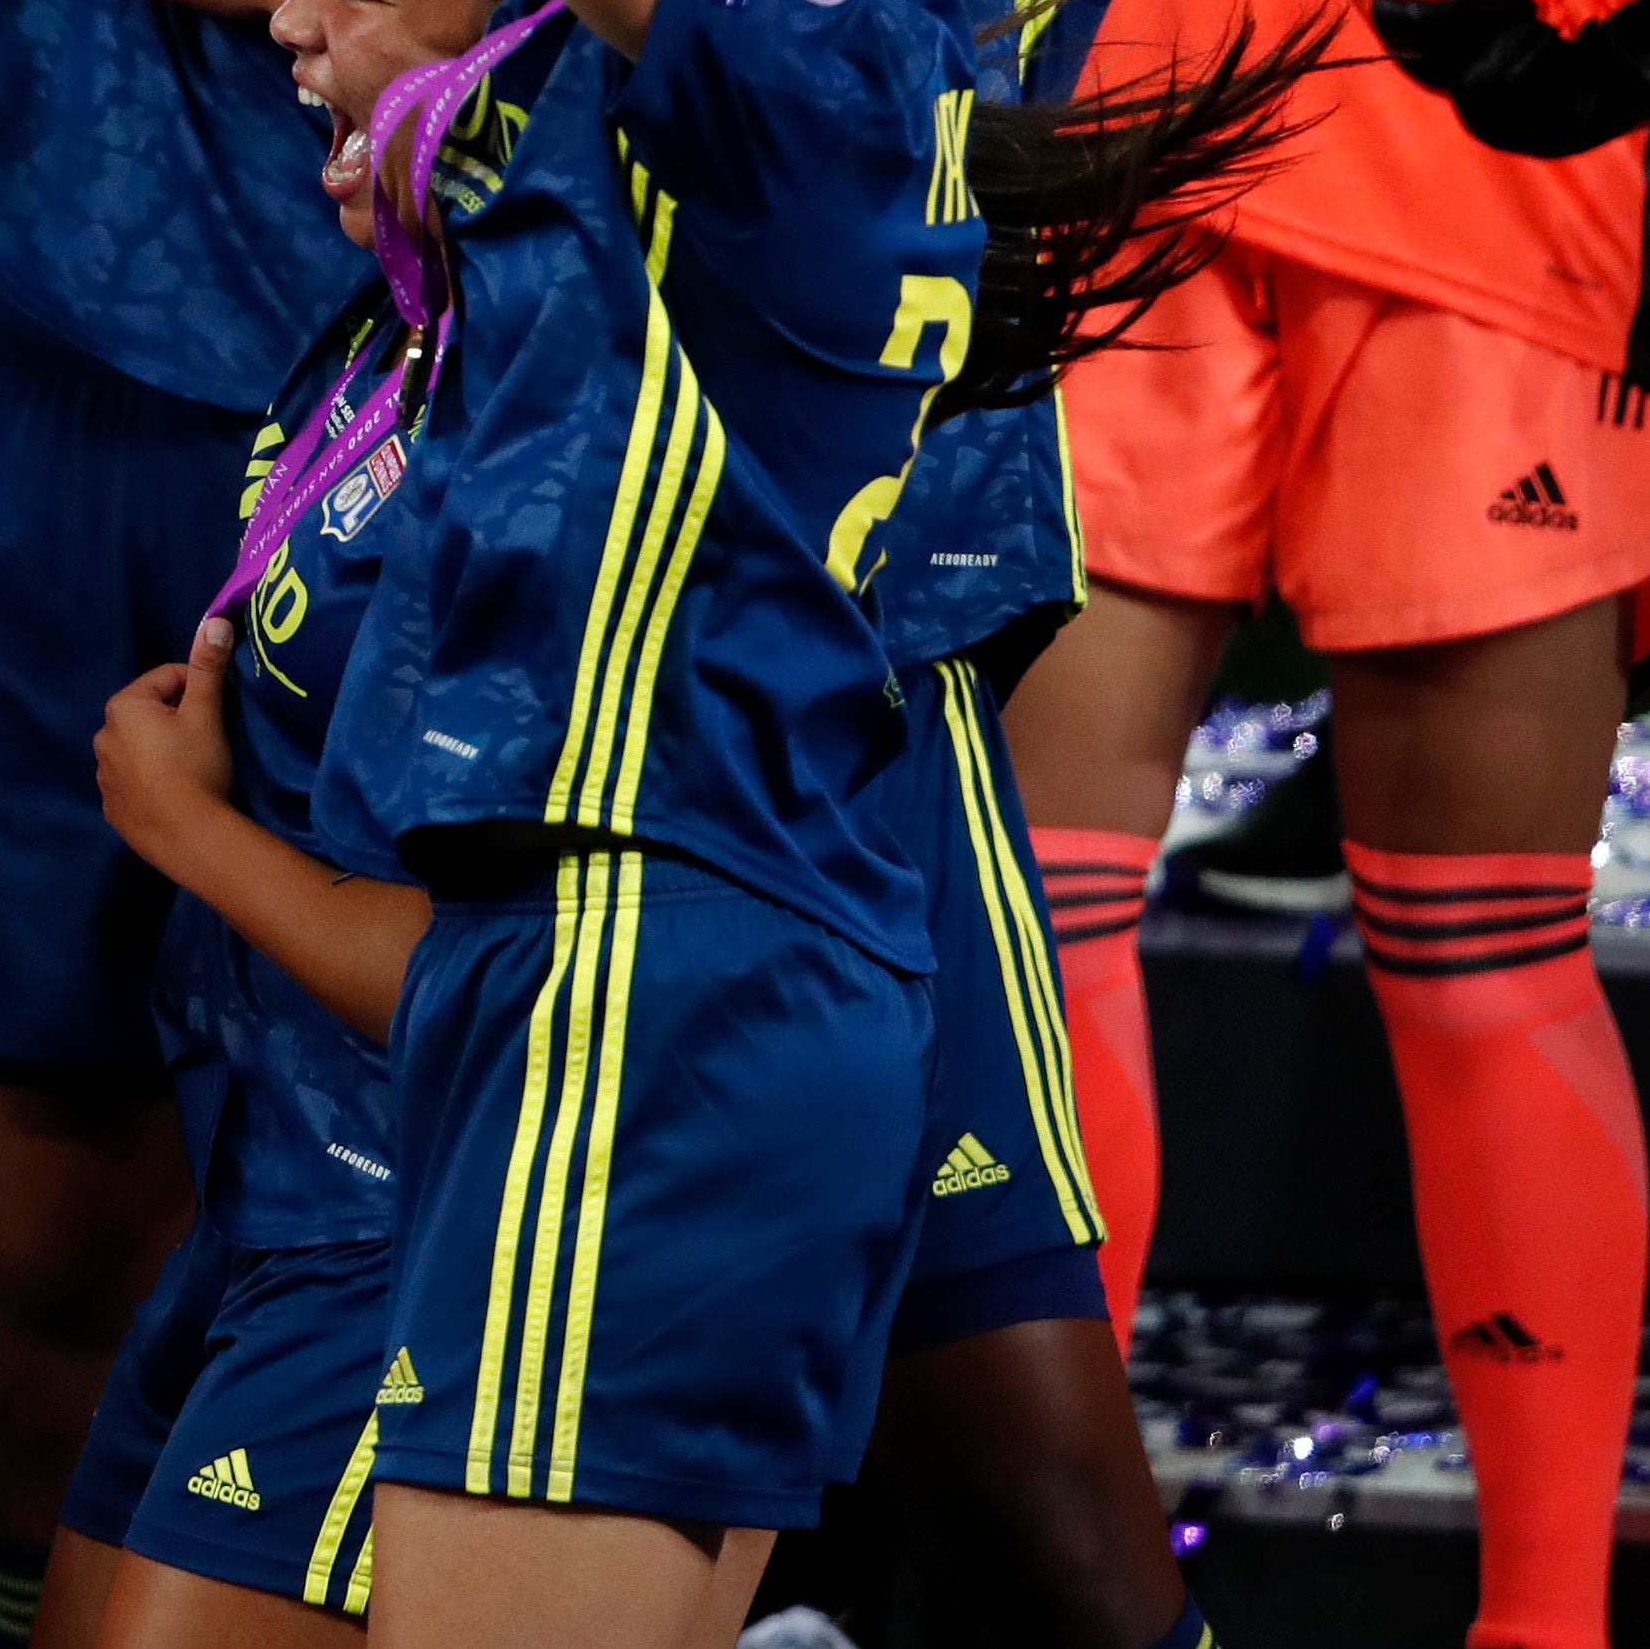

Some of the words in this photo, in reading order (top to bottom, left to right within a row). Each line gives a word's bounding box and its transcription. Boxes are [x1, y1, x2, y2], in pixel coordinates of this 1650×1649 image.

[348, 410, 382, 451] 2020
[318, 450, 345, 483] SAN
[929, 552, 999, 568] AEROREADY
[326, 1142, 391, 1181] AEROREADY
[932, 1164, 1010, 1197] adidas
[375, 1384, 425, 1405] adidas
[187, 1475, 261, 1512] adidas
